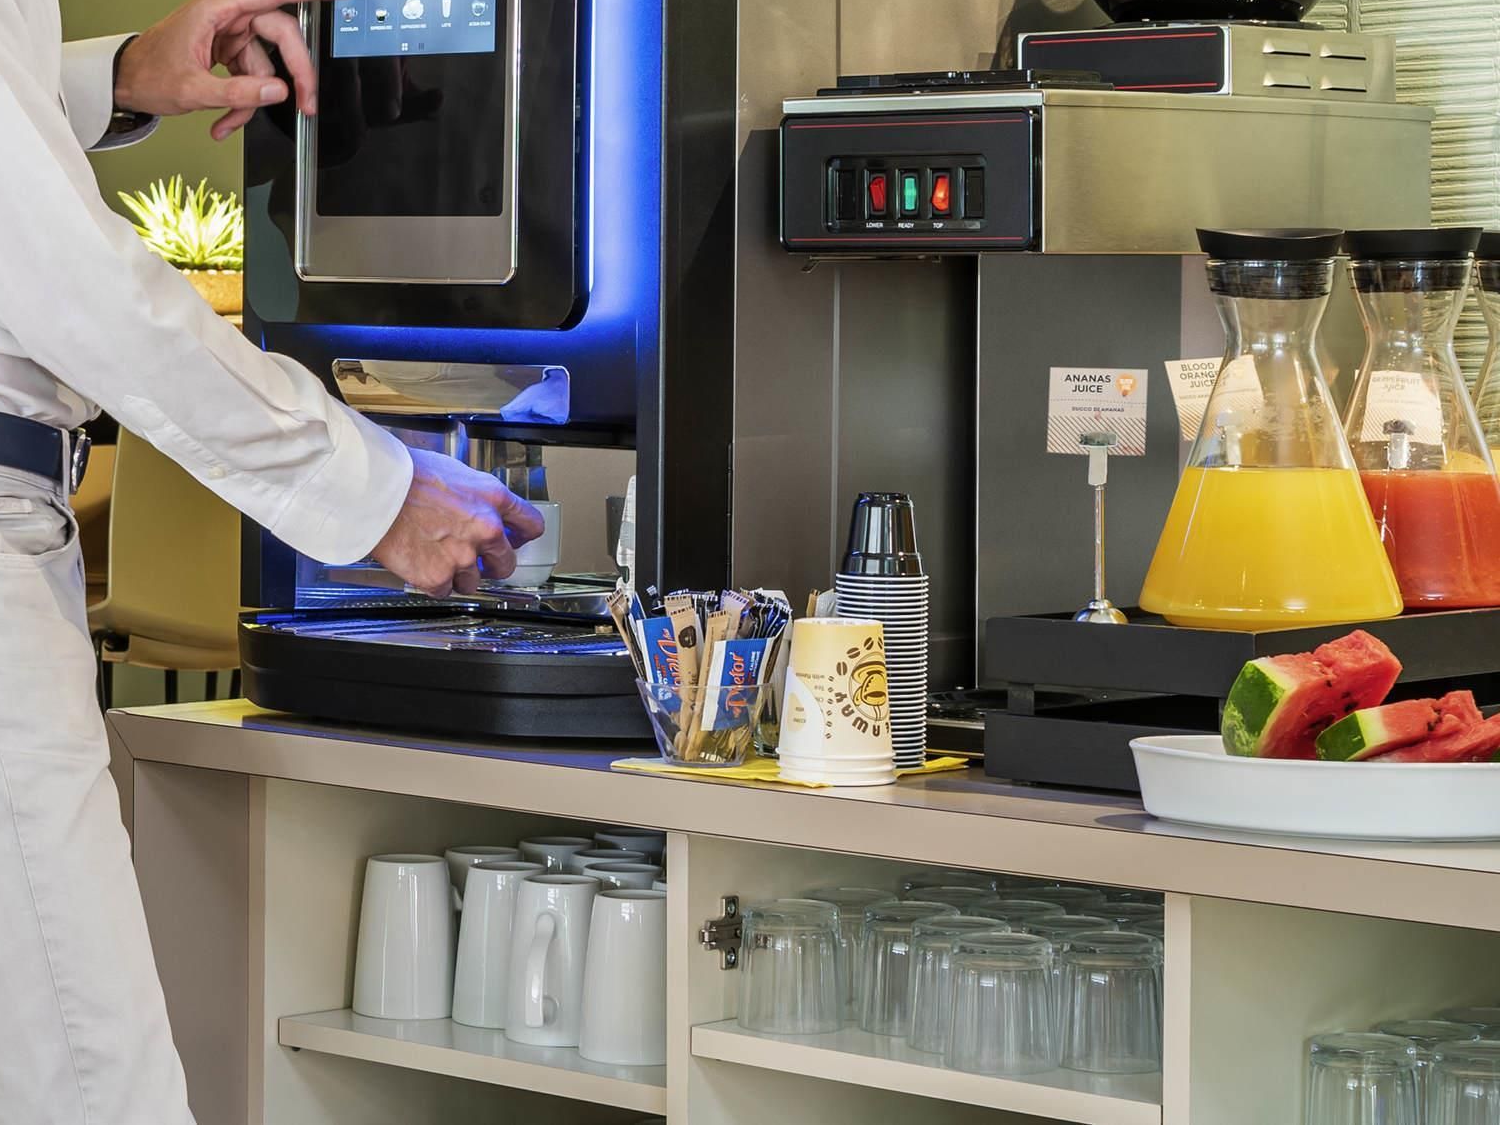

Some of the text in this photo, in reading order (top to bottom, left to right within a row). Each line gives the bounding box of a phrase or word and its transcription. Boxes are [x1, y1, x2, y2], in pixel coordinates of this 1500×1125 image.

[1181, 362, 1215, 372] BLOOD
[1064, 374, 1111, 383] ANANAS
[1190, 379, 1216, 388] JUICE
[1072, 384, 1103, 393] JUICE
